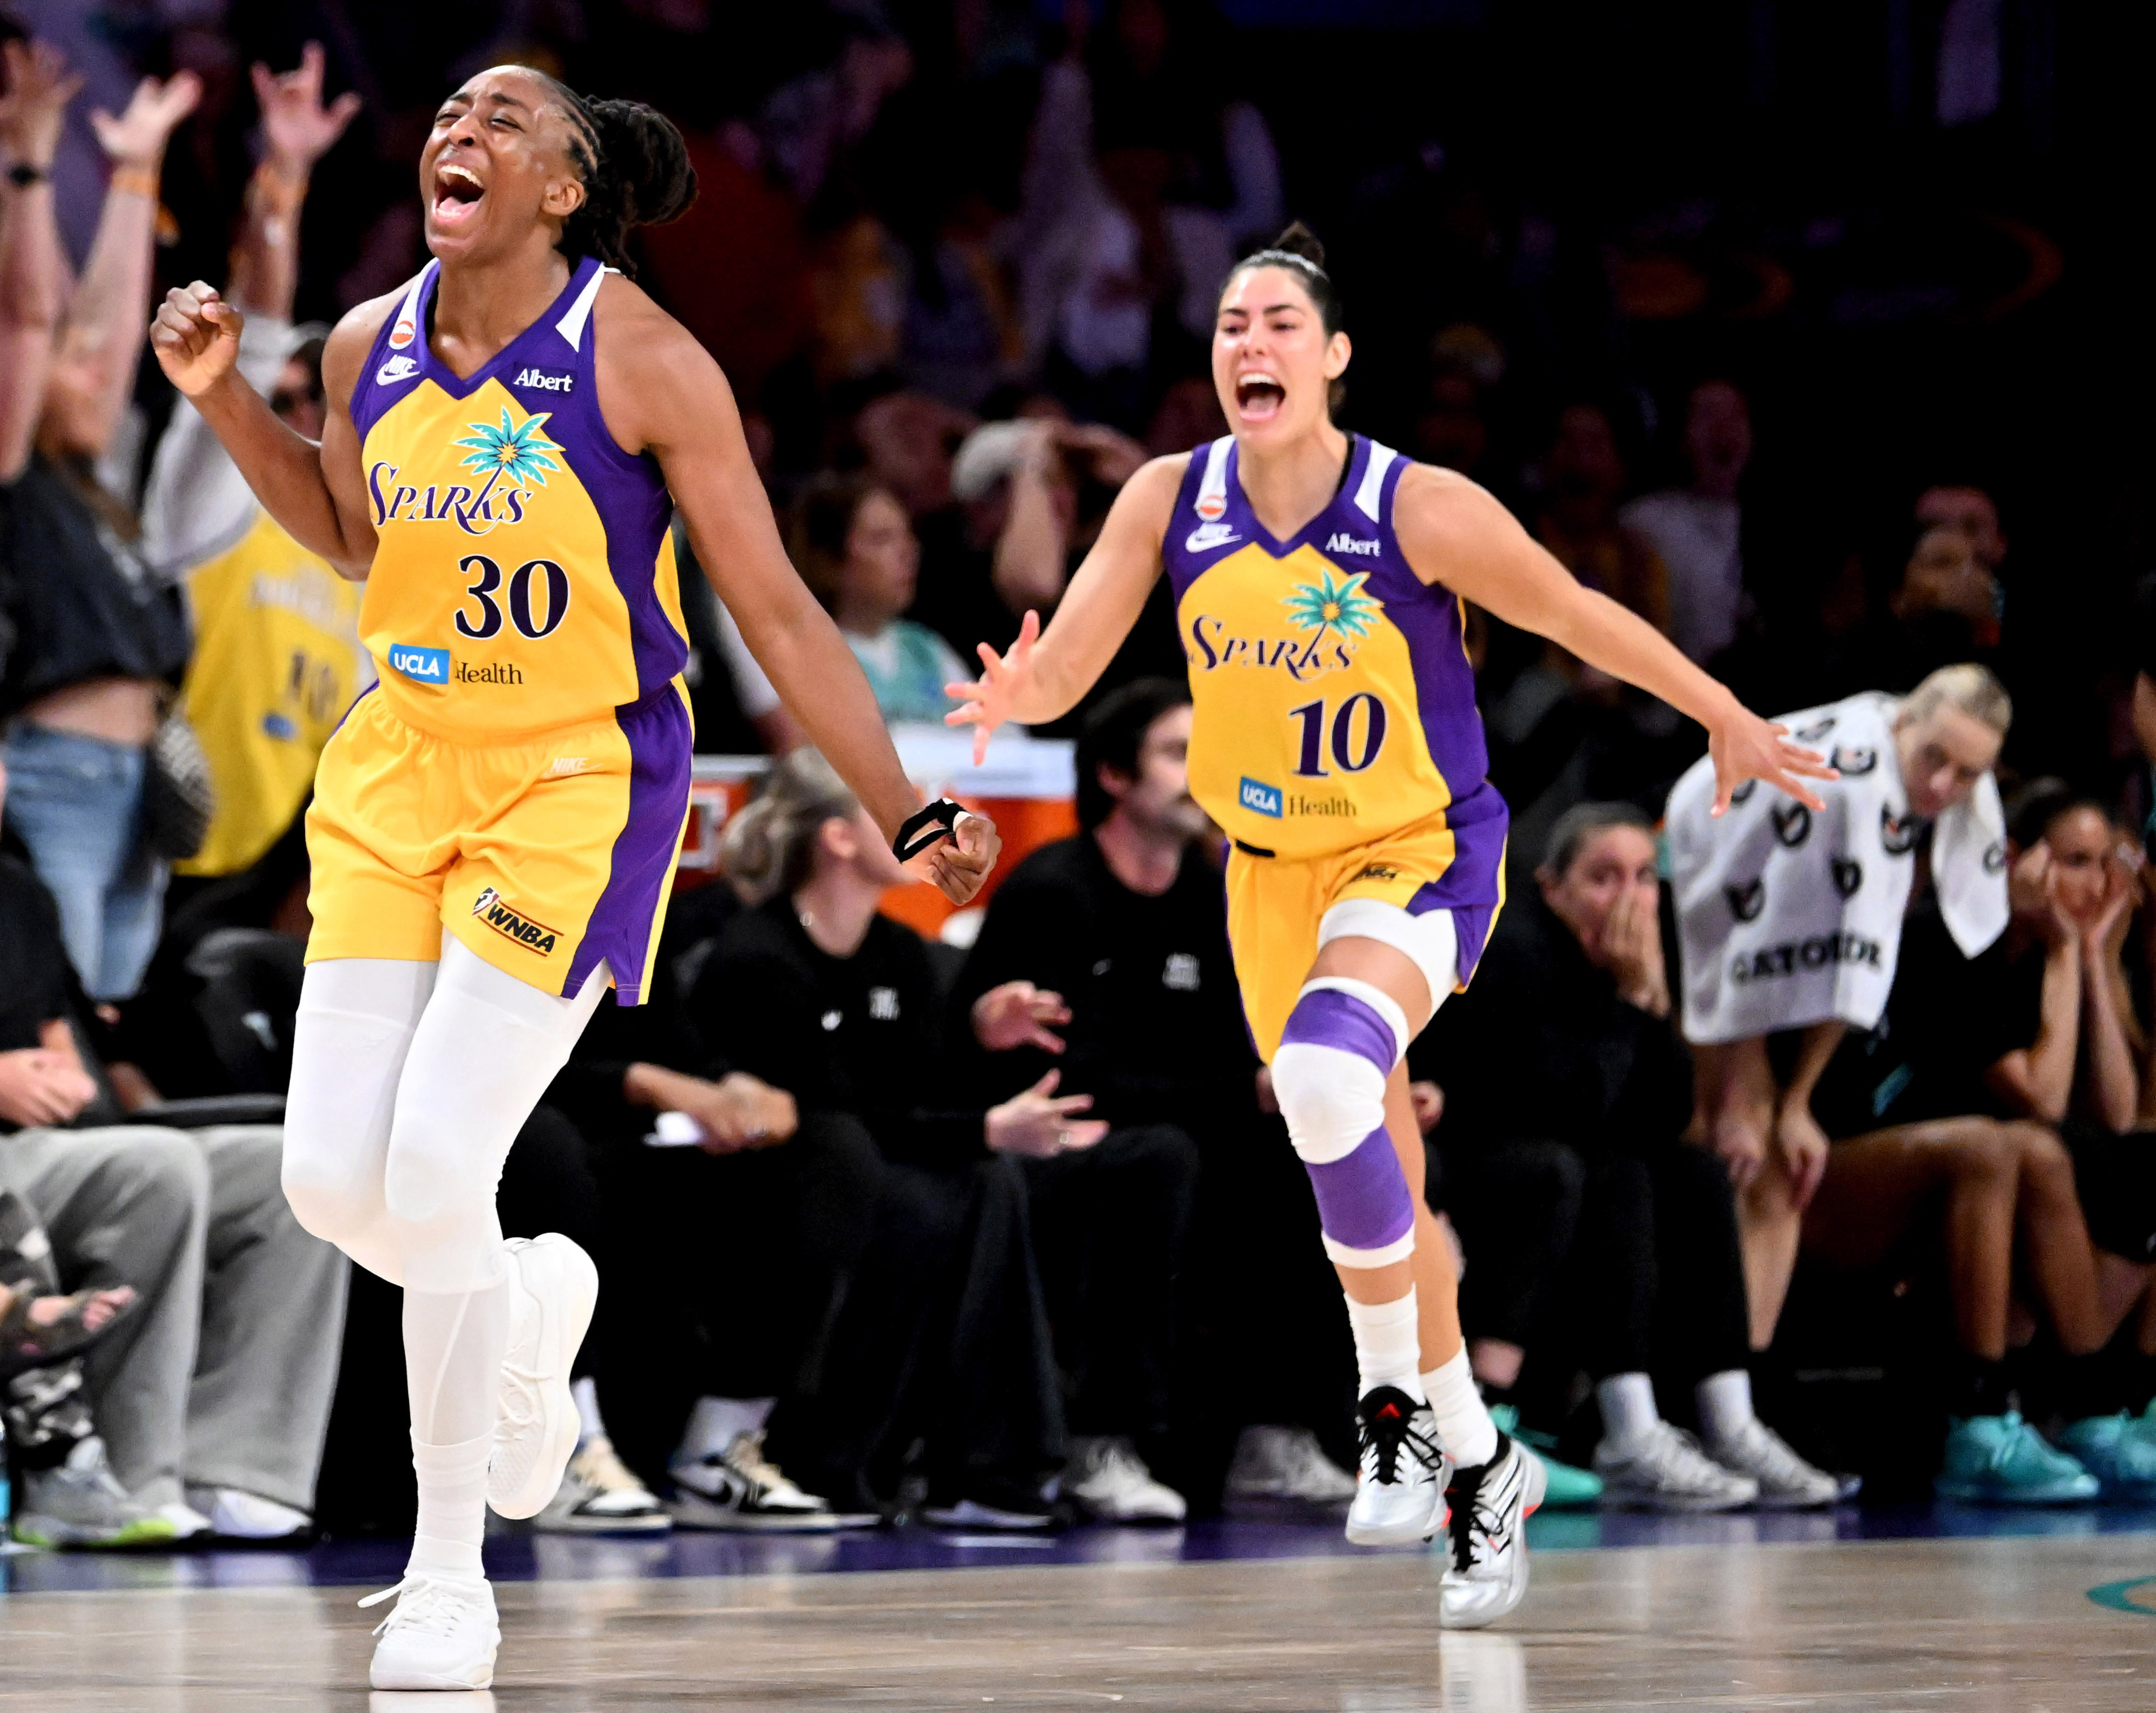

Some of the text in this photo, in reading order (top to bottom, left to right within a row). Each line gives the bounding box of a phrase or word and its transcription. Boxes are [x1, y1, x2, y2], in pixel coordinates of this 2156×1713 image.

[513, 368, 573, 392] Albert
[1325, 532, 1381, 557] Albert
[455, 553, 571, 640] 30
[394, 652, 523, 684] UCLA Health
[1289, 691, 1387, 777] 10
[550, 757, 589, 773] NIKE
[1243, 784, 1357, 816] UCLA Health
[487, 904, 556, 953] WNBA
